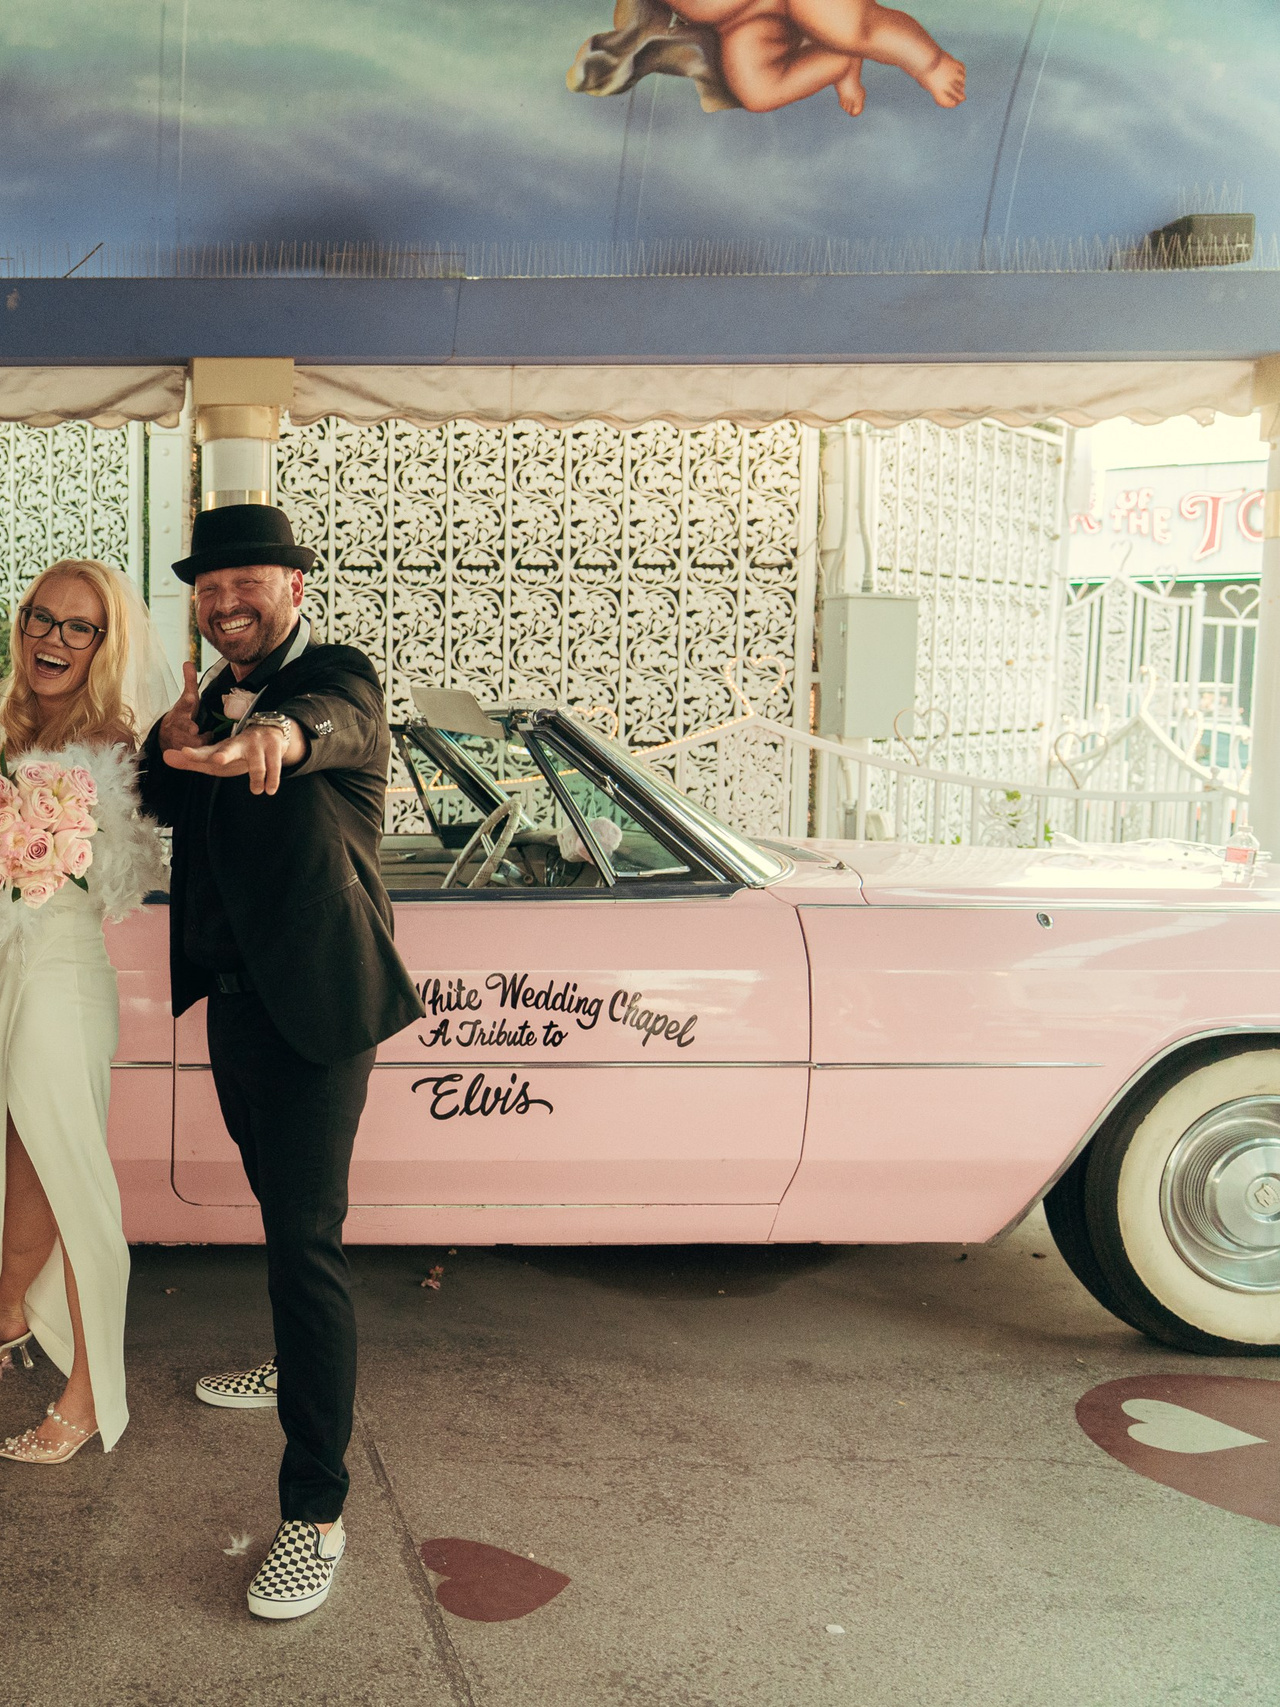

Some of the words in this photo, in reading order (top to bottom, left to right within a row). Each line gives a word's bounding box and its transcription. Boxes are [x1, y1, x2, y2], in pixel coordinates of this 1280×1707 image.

[1110, 507, 1172, 544] THE
[486, 972, 604, 1030] Wedding
[609, 989, 698, 1048] Chapel
[418, 1018, 452, 1047] A
[456, 1018, 538, 1047] Tribute
[542, 1020, 569, 1047] to
[411, 1072, 554, 1120] Elvis
